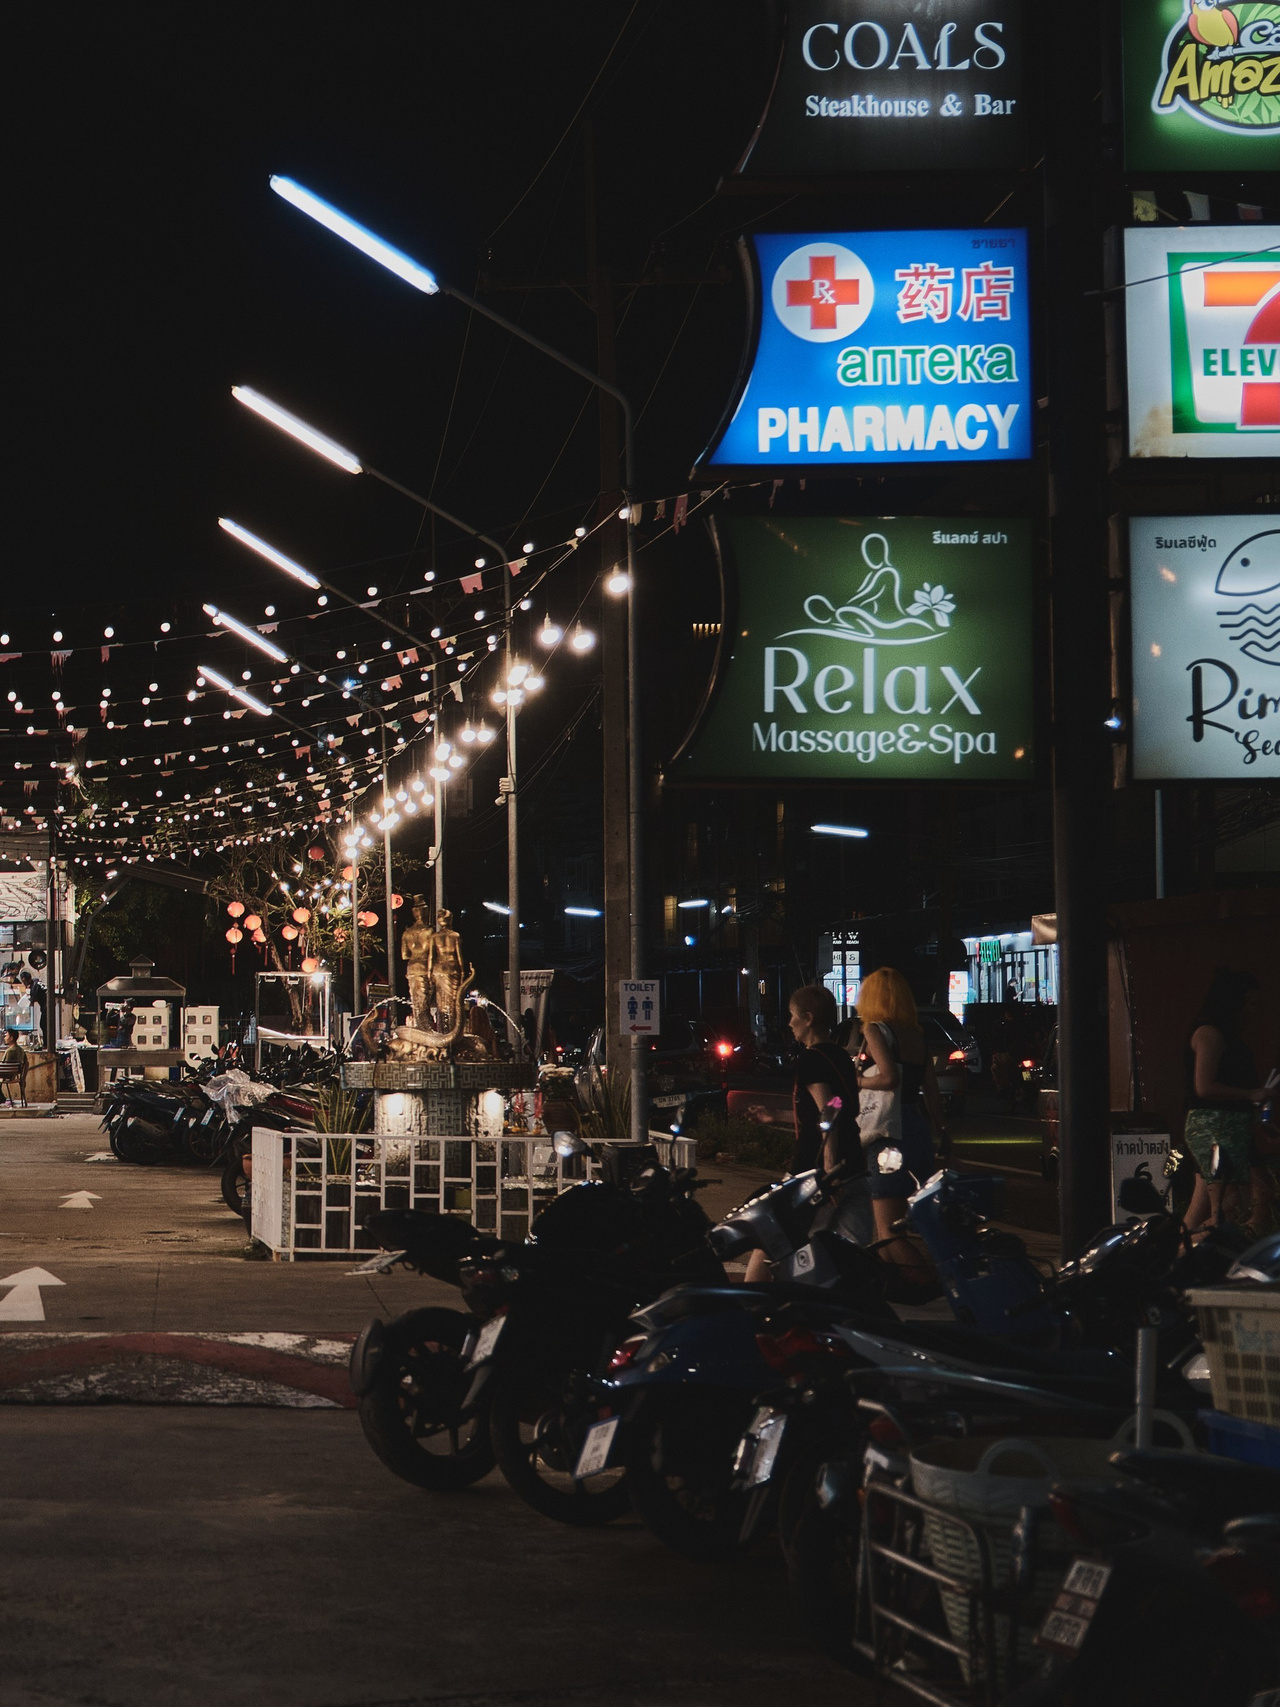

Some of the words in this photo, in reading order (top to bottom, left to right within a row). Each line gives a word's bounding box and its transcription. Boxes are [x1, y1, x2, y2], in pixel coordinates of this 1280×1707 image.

[802, 21, 1006, 71] COALS
[805, 93, 929, 118] Steakhouse
[940, 94, 963, 117] &
[974, 93, 1017, 117] Bar
[895, 261, 1014, 324] 药店
[837, 344, 1019, 387] аптека
[757, 403, 1019, 453] PHARMACY
[982, 531, 1008, 544] สปา
[762, 646, 982, 717] Relax
[623, 983, 656, 992] TOILET
